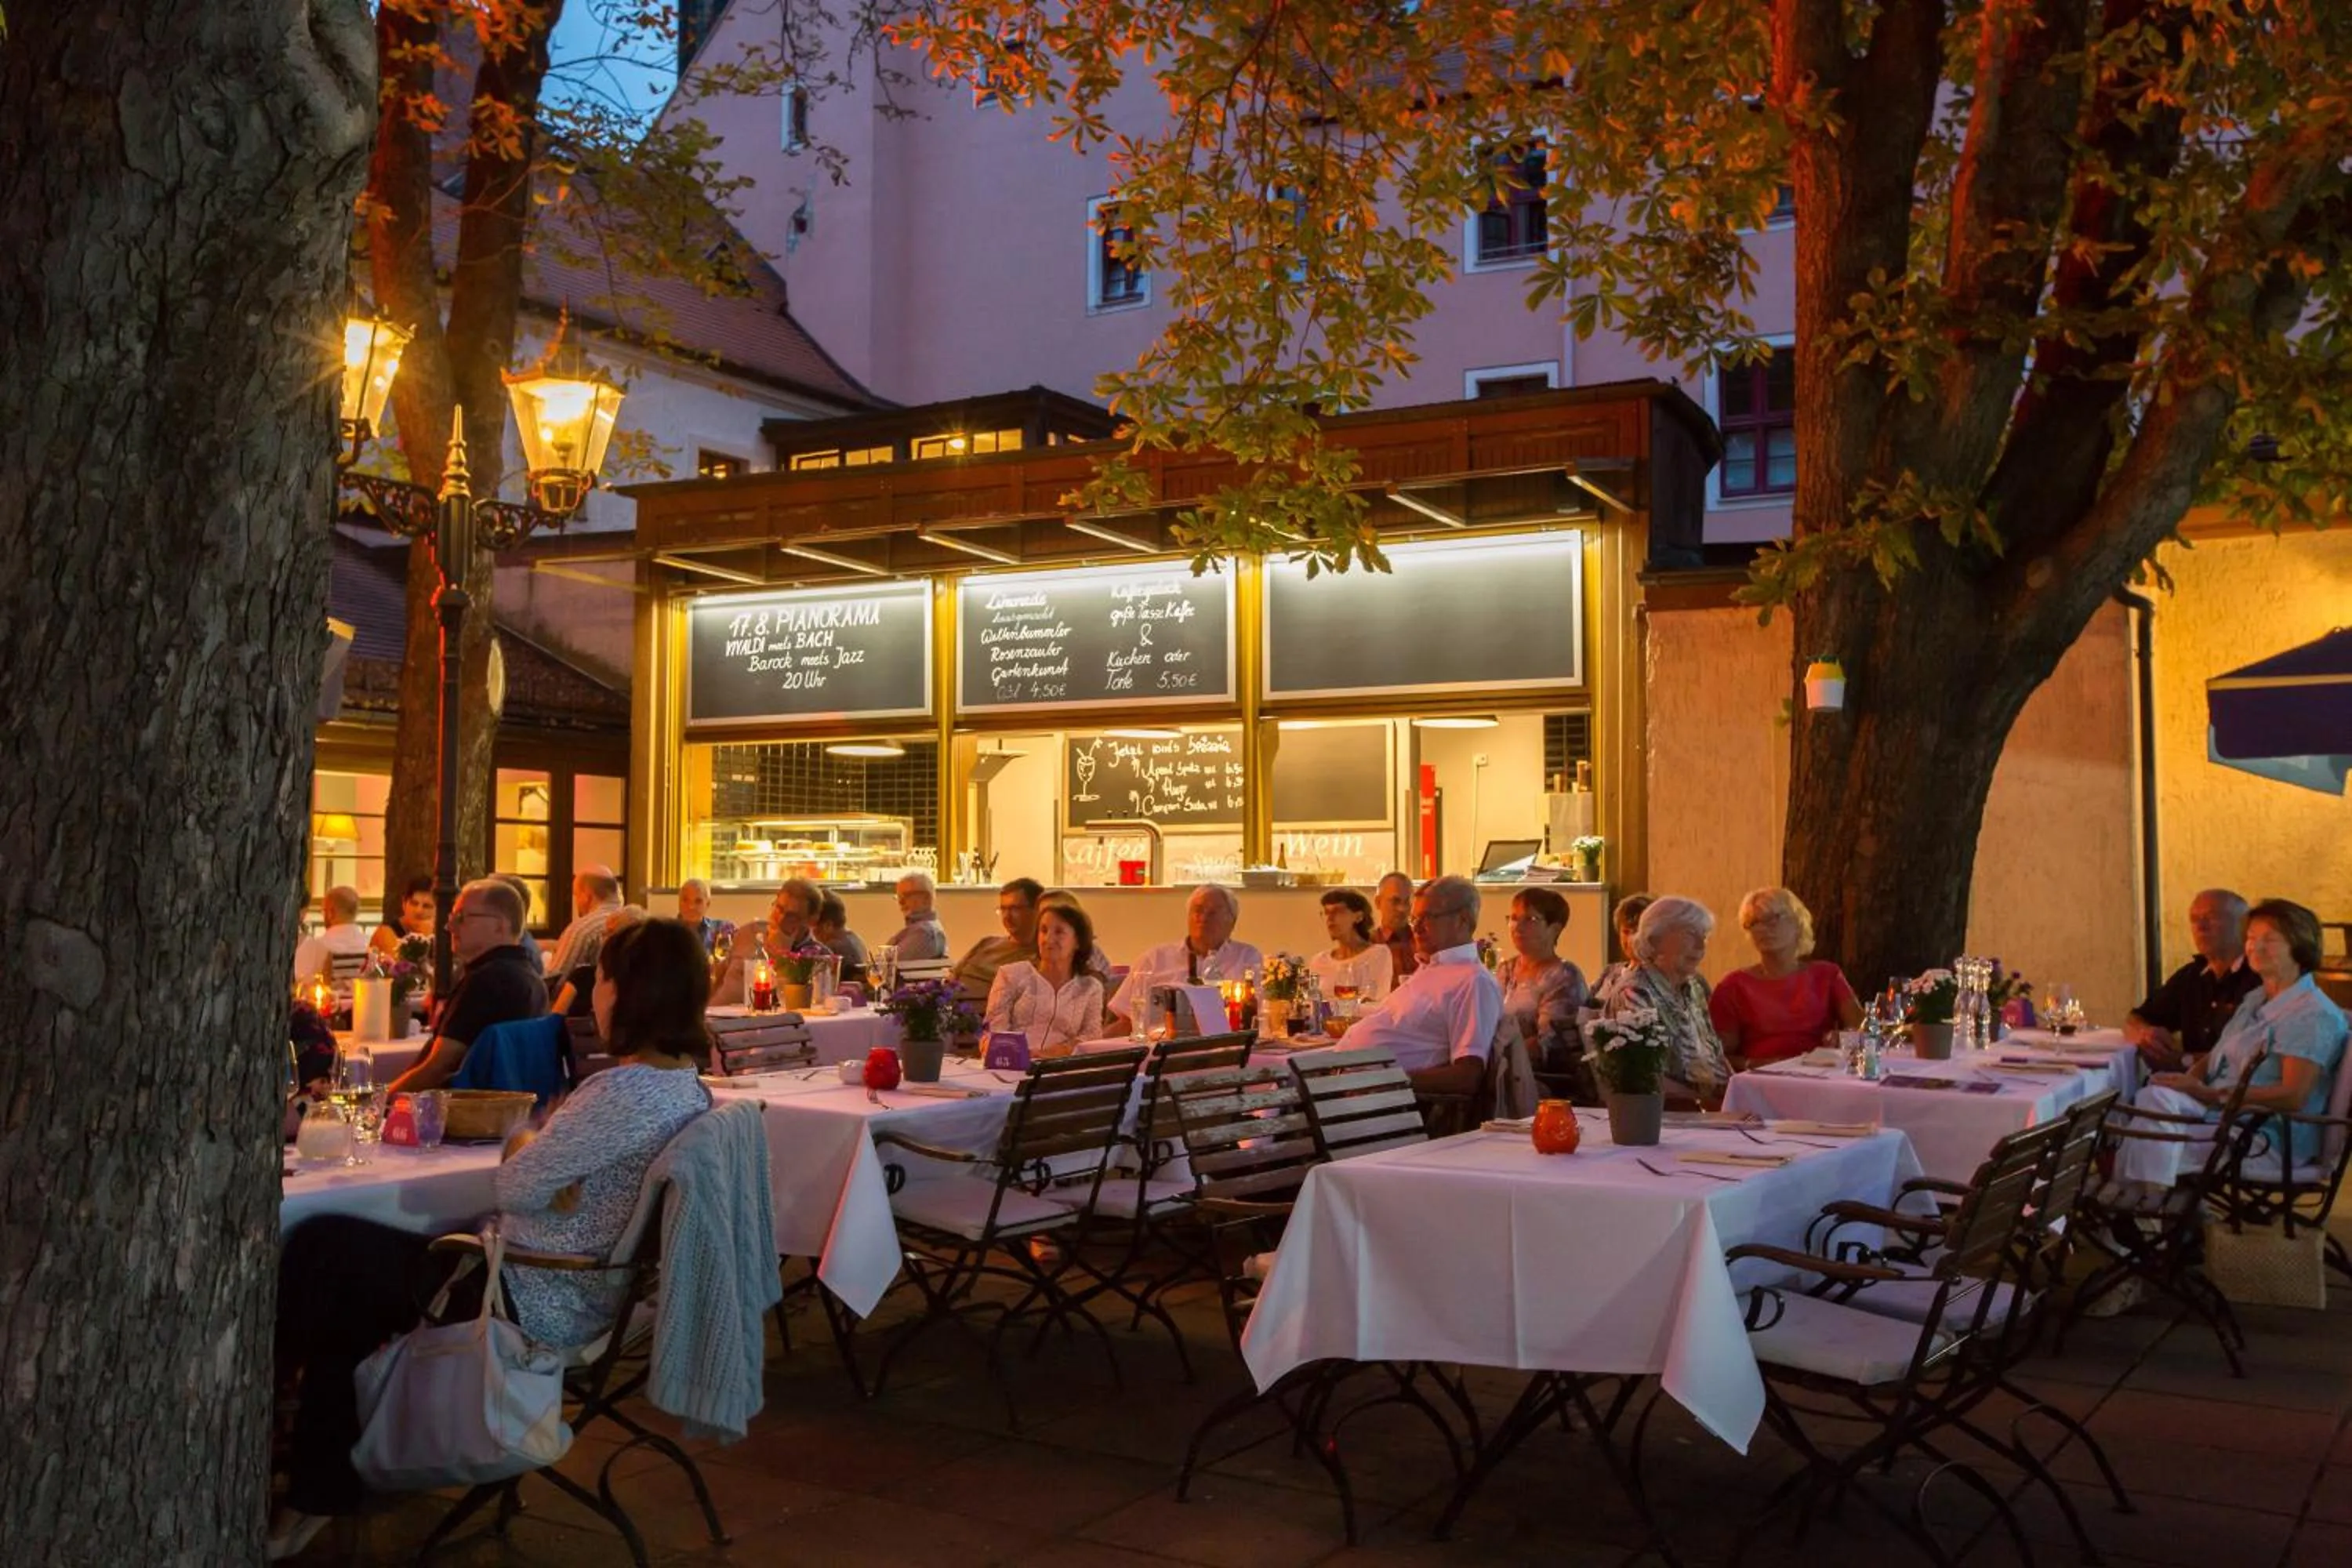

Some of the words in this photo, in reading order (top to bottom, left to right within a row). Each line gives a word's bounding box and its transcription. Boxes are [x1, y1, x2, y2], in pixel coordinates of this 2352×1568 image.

[775, 602, 880, 633] PIANORAMA
[725, 637, 765, 657] VIVALDI
[768, 637, 792, 652] meets
[796, 630, 834, 648] BACH
[1140, 623, 1153, 647] &
[747, 652, 793, 672] Barock
[801, 649, 829, 666] meets
[833, 646, 865, 669] Jazz
[1106, 647, 1152, 666] Kuchen
[1164, 648, 1192, 662] oder
[782, 672, 802, 689] 20
[804, 669, 827, 688] Uhr
[1105, 667, 1134, 690] Torte
[1287, 829, 1364, 858] Wein
